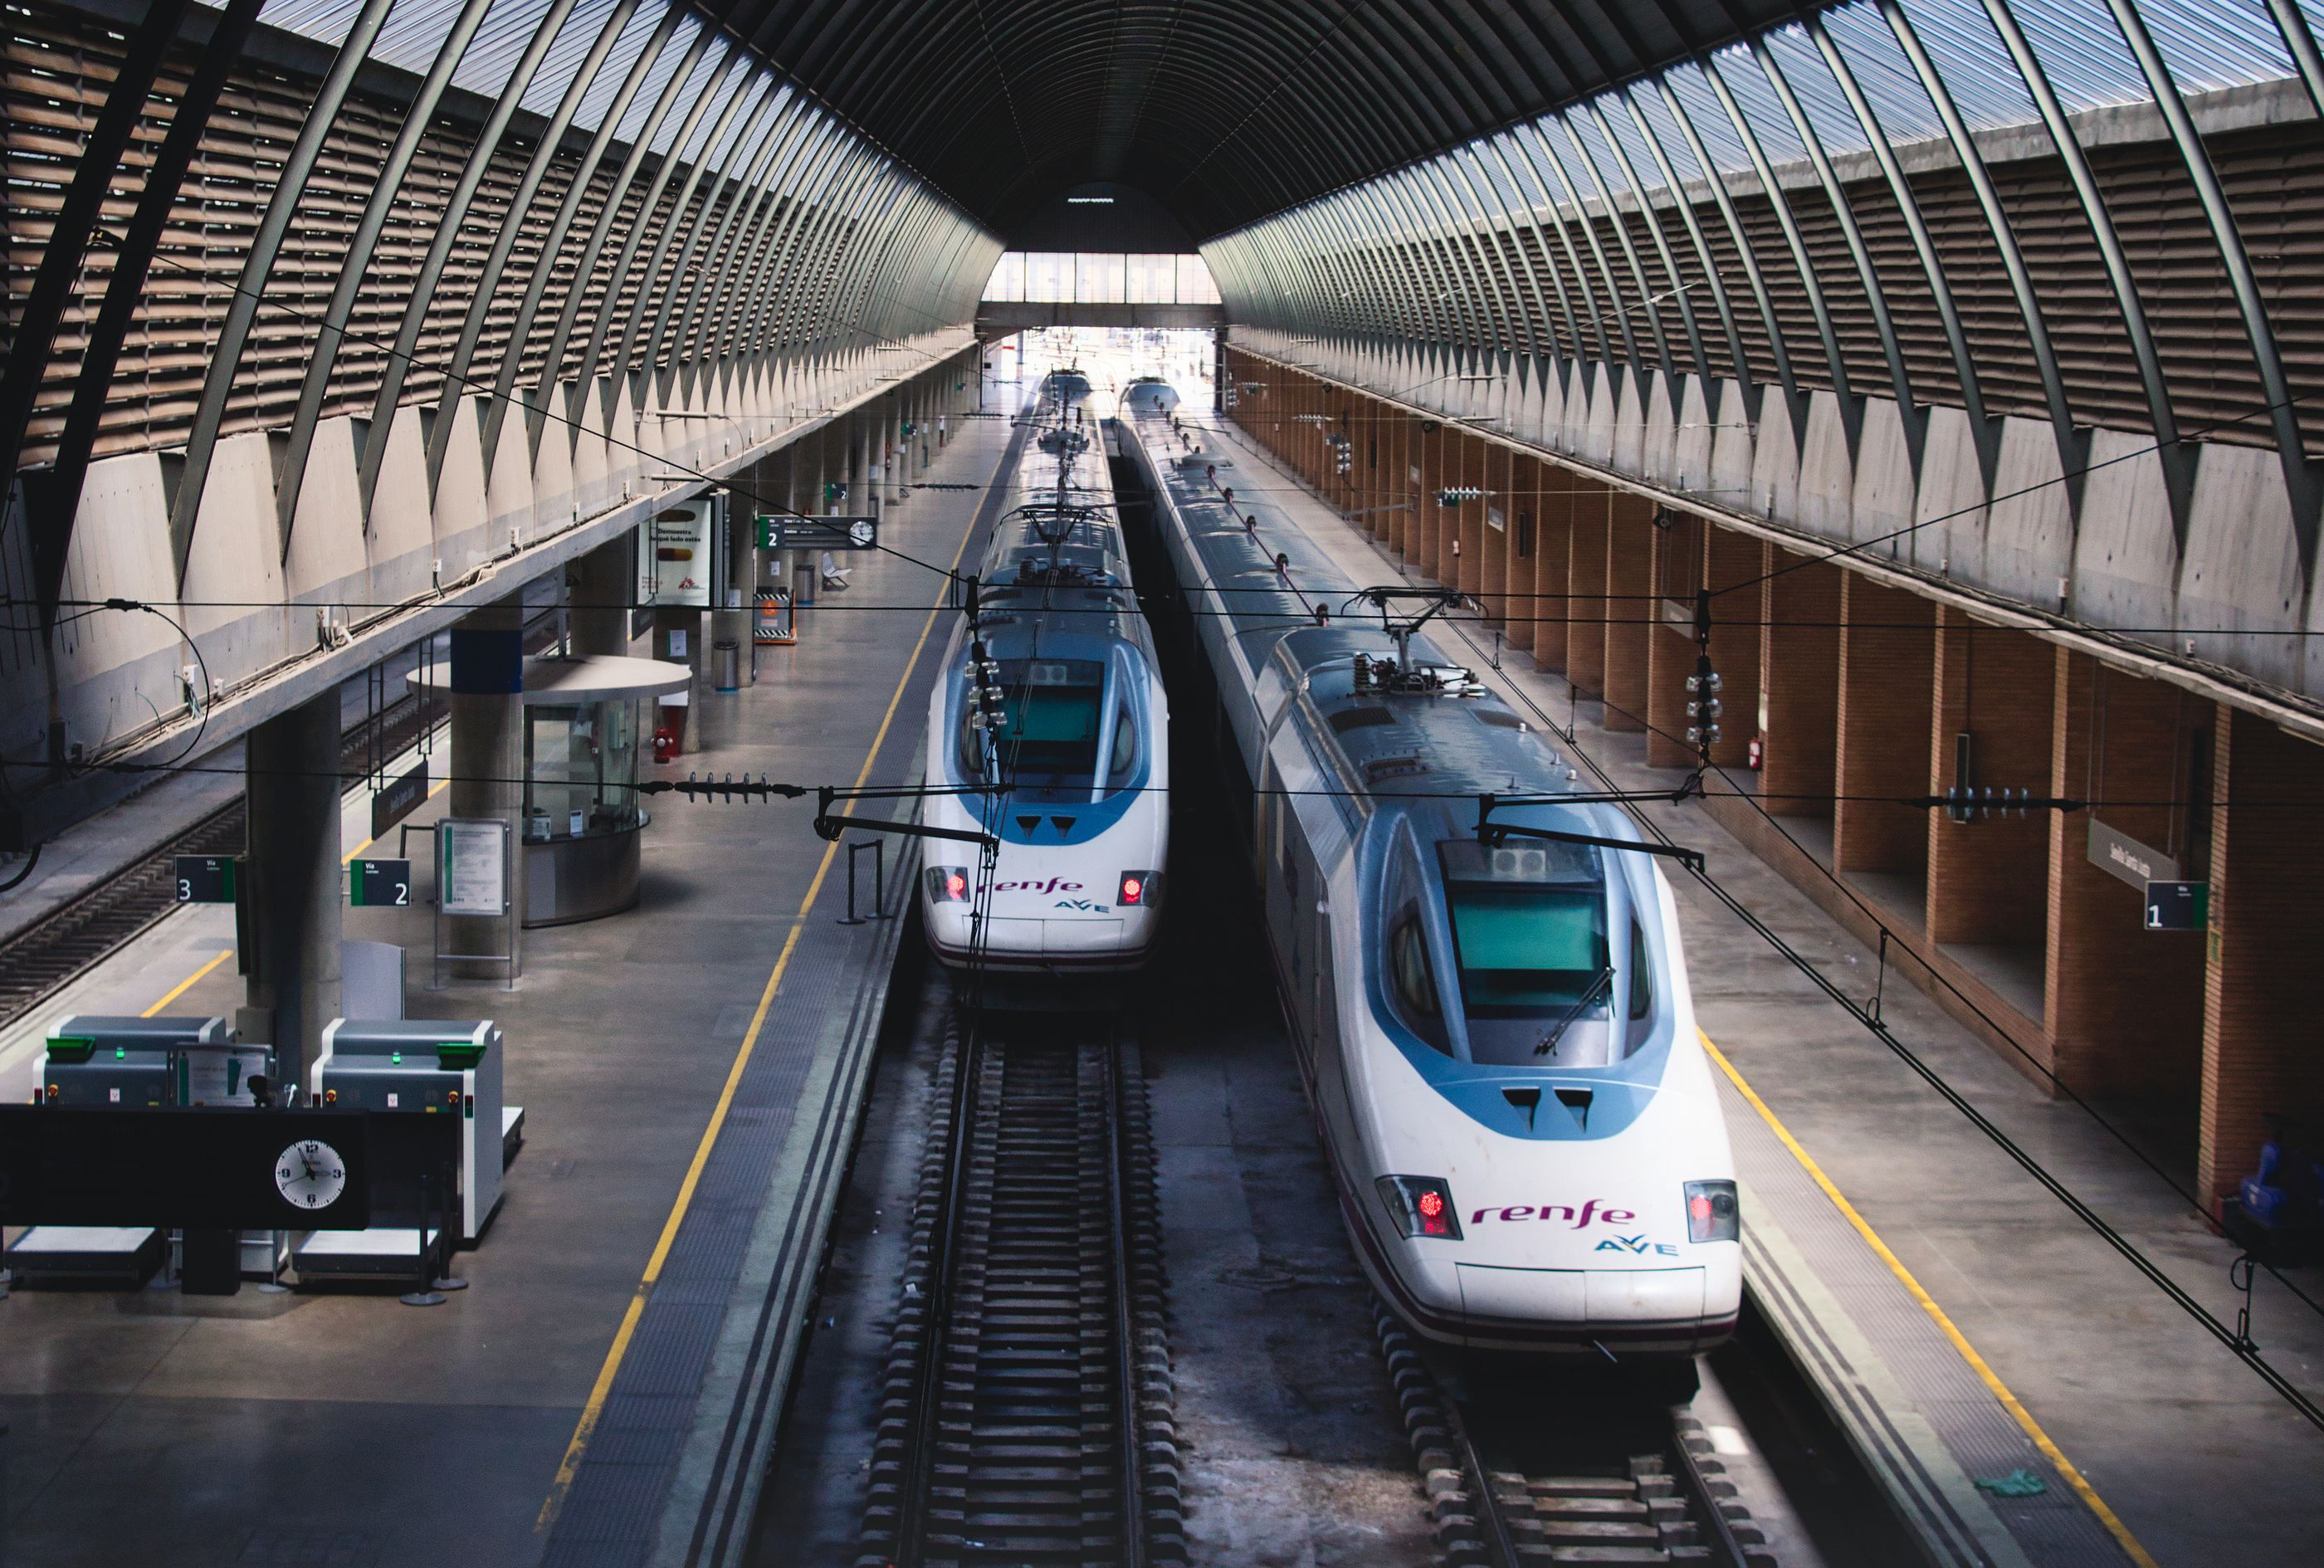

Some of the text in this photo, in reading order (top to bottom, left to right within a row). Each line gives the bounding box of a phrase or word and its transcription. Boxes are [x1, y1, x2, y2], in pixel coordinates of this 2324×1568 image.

[841, 491, 847, 500] 2
[768, 532, 778, 546] 2
[365, 862, 375, 870] Vía
[178, 879, 191, 901] 3
[977, 876, 1084, 895] renfe
[394, 882, 408, 905] 2
[1054, 897, 1110, 914] AVE
[2149, 905, 2163, 927] 1
[305, 1145, 319, 1154] 12
[281, 1168, 290, 1178] 9
[333, 1169, 341, 1179] 3
[307, 1194, 316, 1204] 6
[1471, 1199, 1635, 1229] renfe
[1594, 1234, 1679, 1256] AVE
